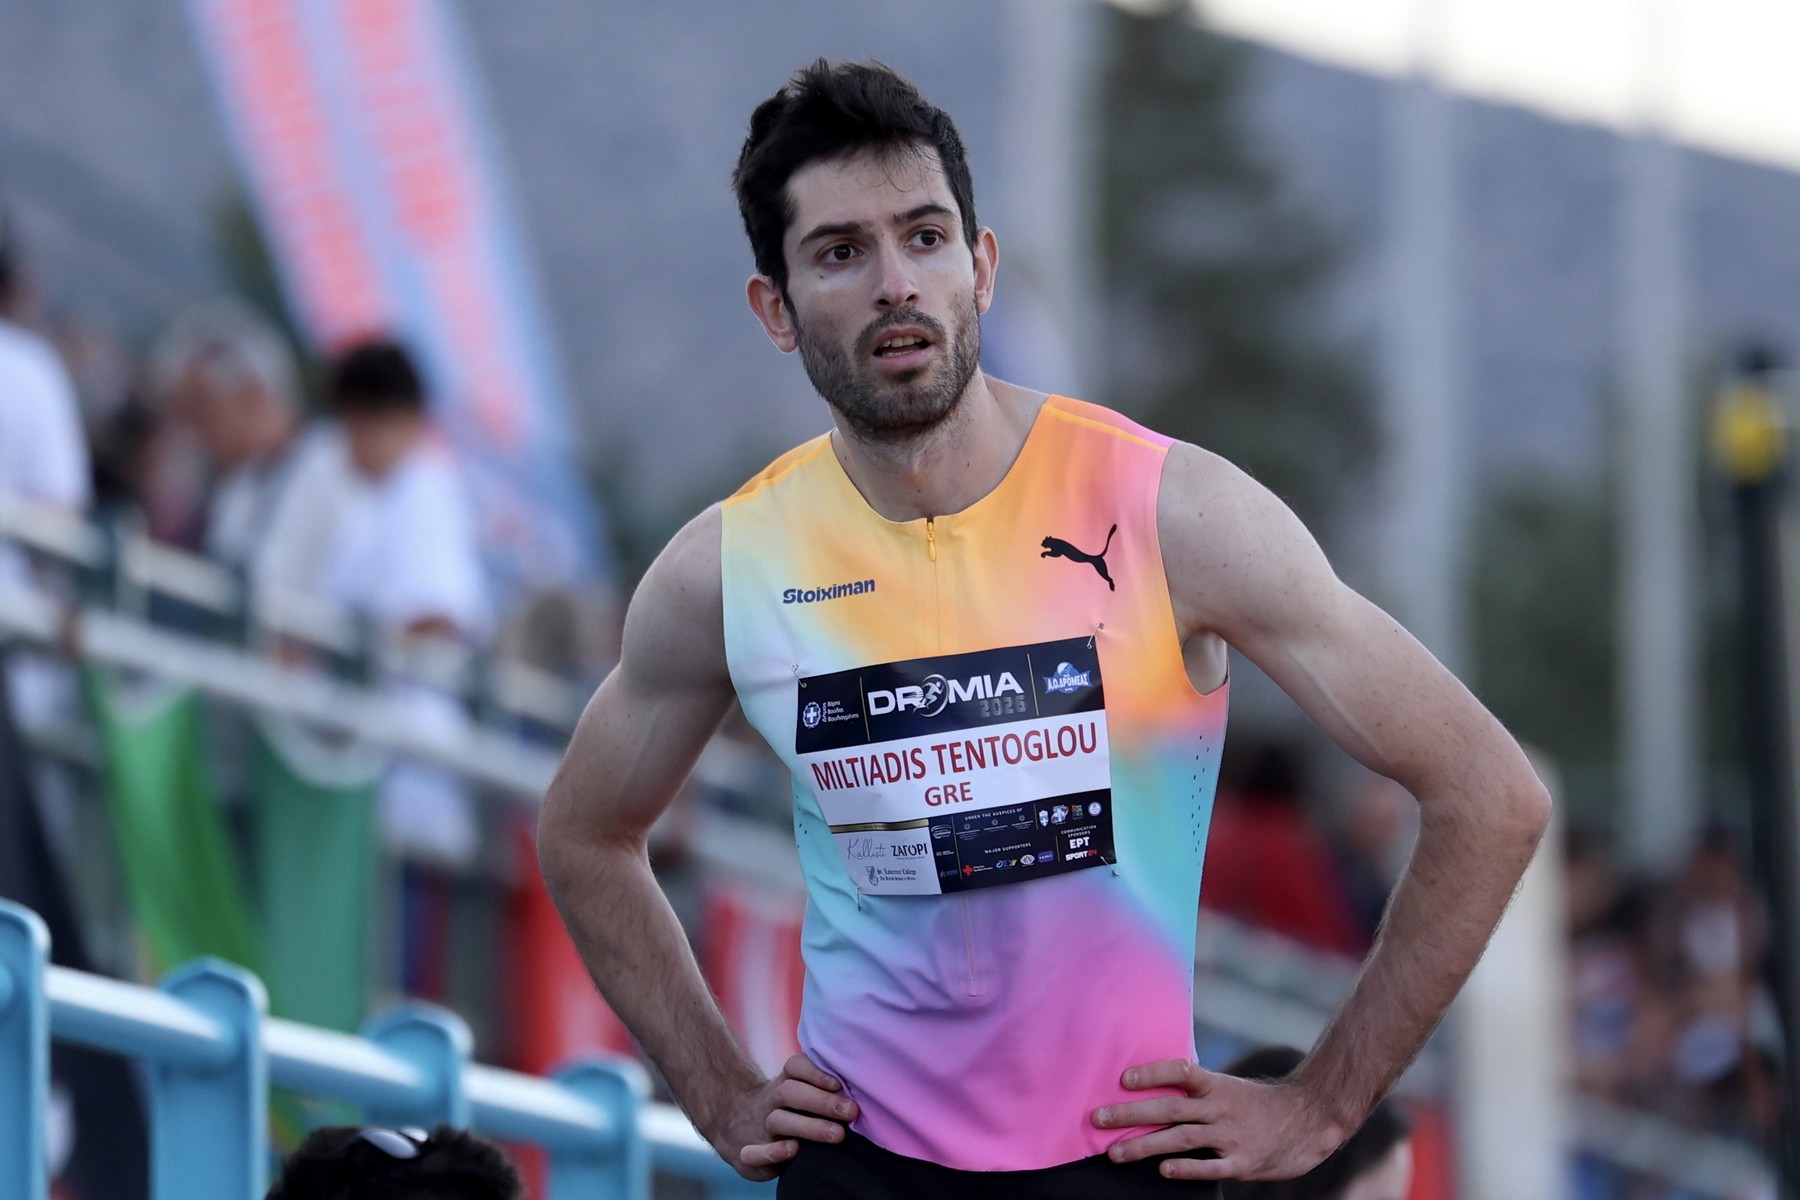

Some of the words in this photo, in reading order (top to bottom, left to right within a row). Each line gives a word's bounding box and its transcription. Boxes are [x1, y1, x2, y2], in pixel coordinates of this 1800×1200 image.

[783, 579, 876, 604] Stoiximan
[979, 695, 1026, 718] 2026
[811, 748, 927, 791] MILTIADIS
[931, 722, 1097, 775] TENTOGLOU
[924, 781, 973, 807] GRE
